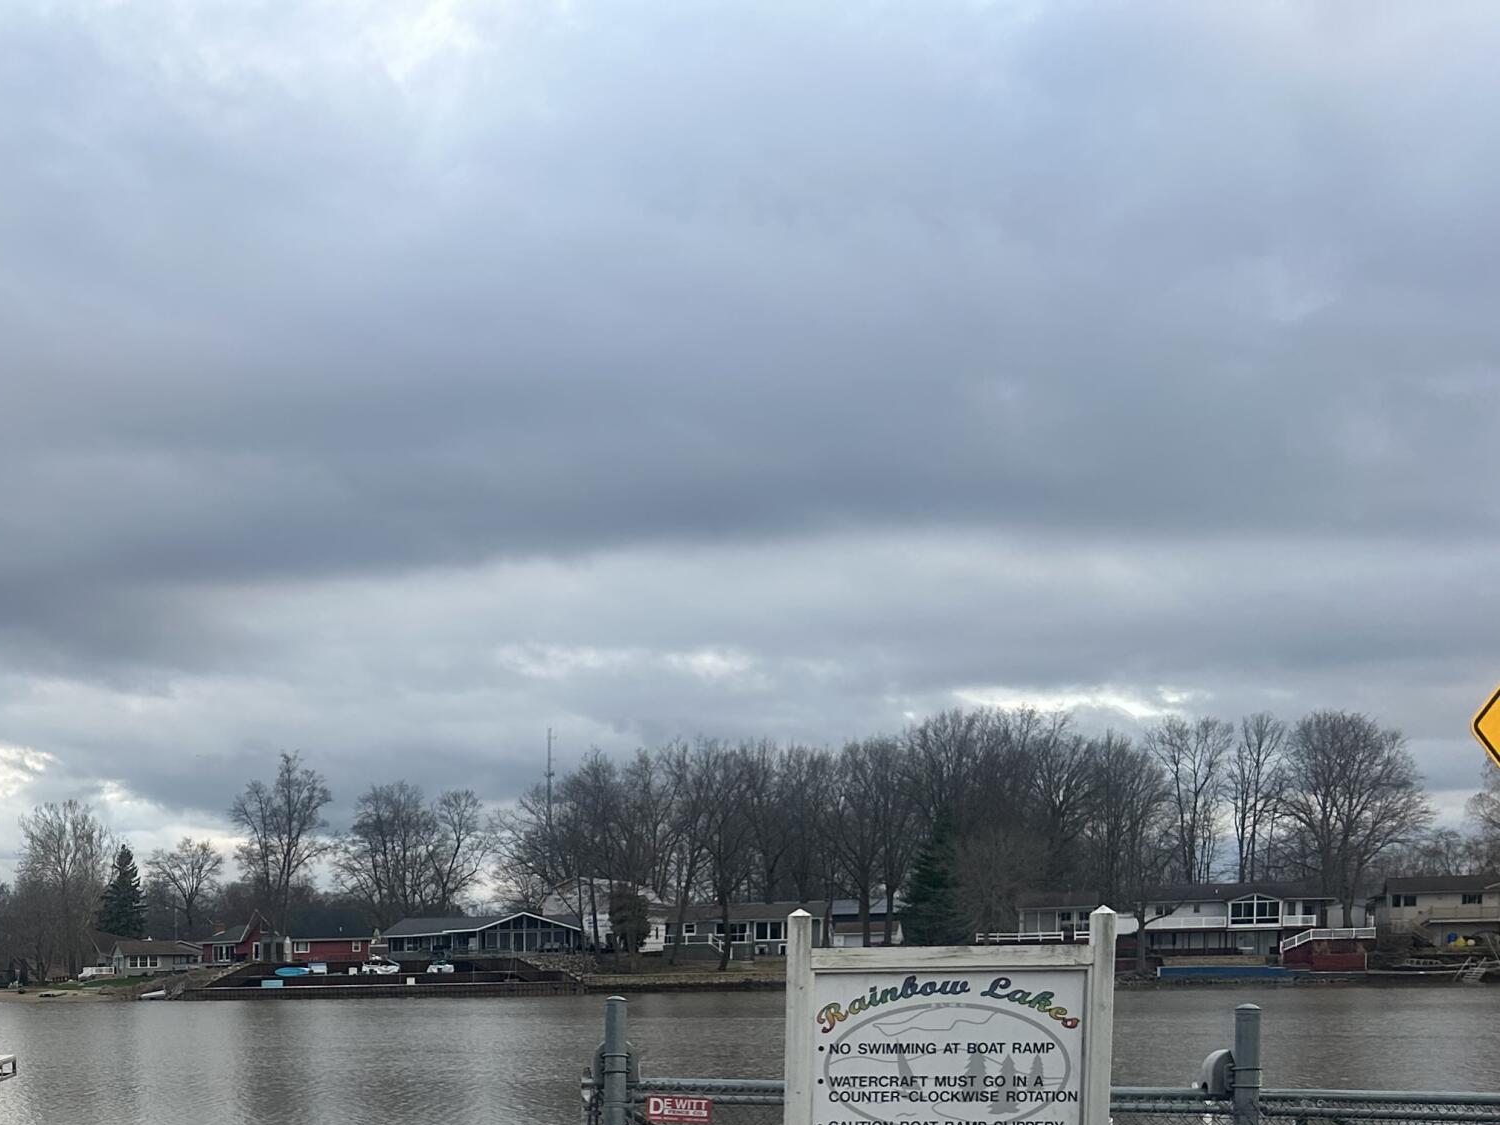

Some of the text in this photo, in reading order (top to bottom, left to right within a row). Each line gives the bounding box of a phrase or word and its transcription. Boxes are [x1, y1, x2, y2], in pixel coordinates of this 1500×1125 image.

[817, 975, 1080, 1033] Rainbow Lakes
[829, 1042, 1055, 1055] NO SWIMMING AT BOAT RAMP
[829, 1075, 1044, 1088] WATERCRAFT MUST GO IN A
[828, 1090, 1078, 1103] COUNTER-CLOCKWISE ROTATION
